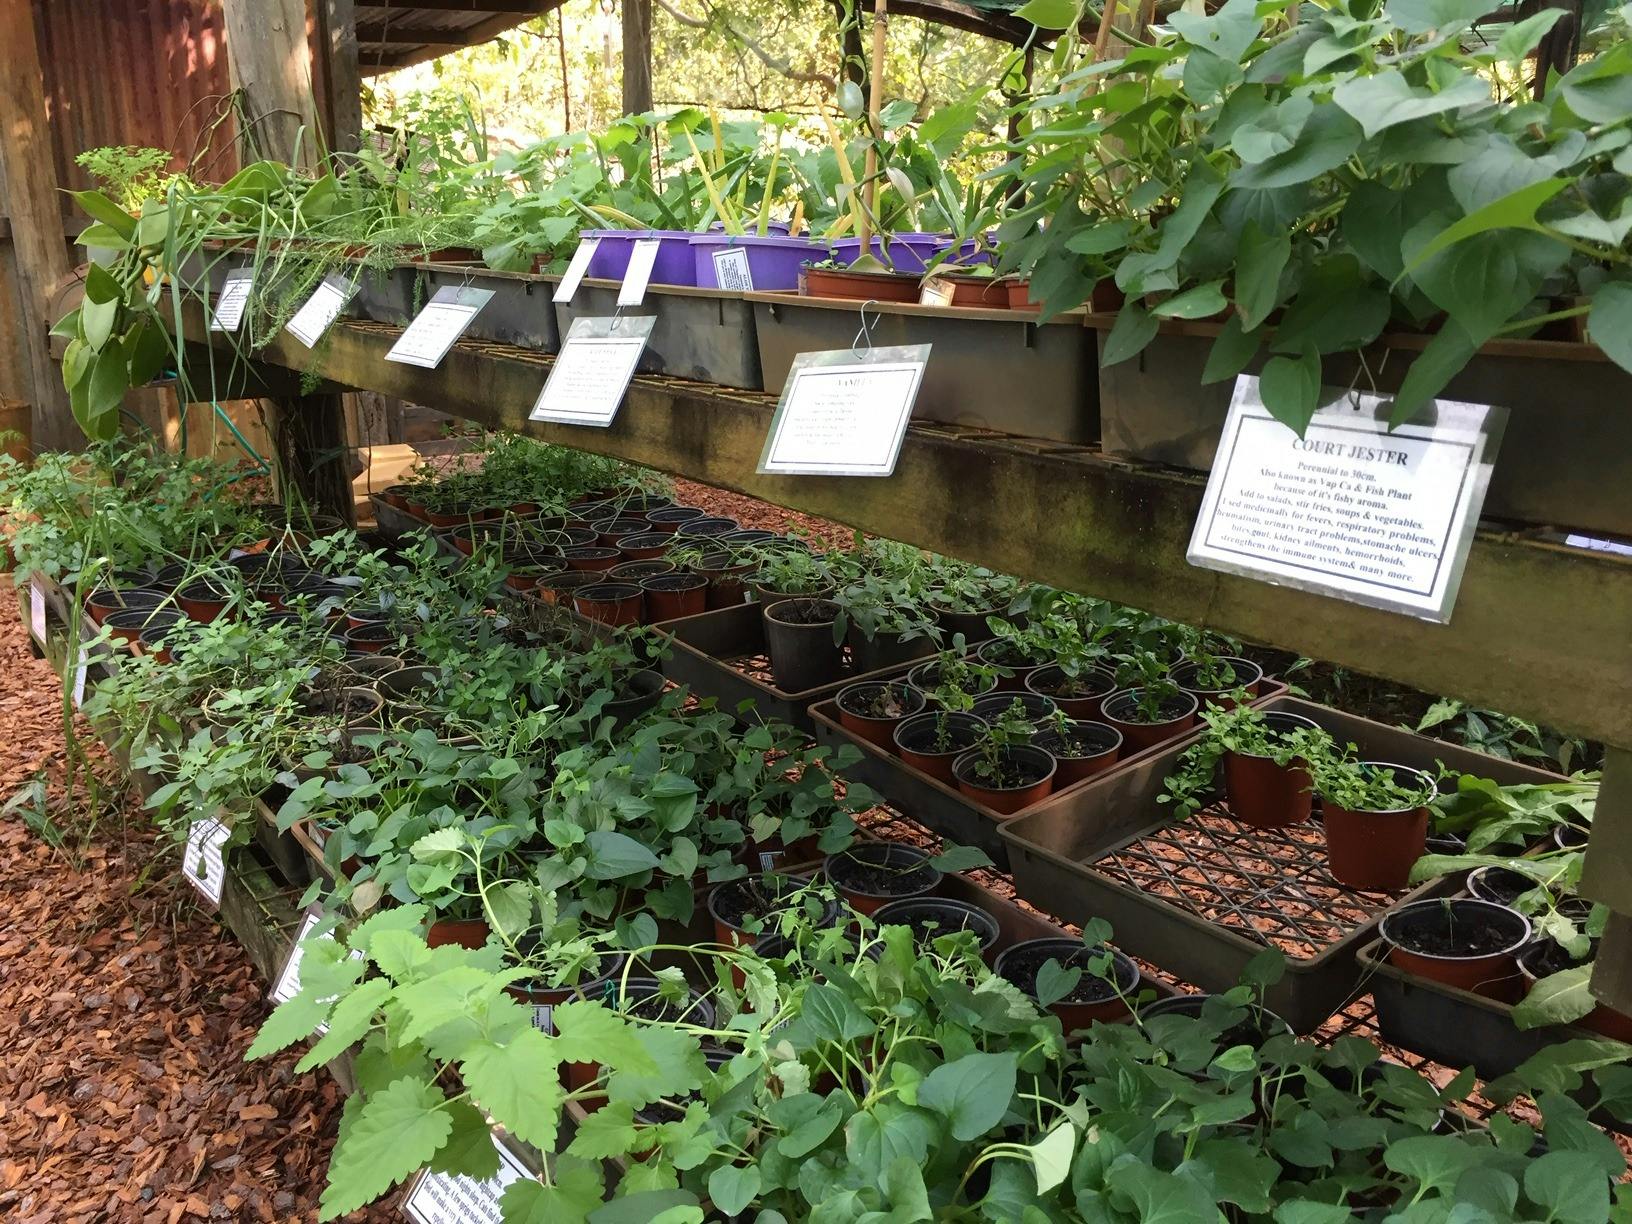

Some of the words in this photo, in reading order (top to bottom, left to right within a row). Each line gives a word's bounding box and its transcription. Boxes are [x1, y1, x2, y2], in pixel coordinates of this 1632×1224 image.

[1292, 438, 1346, 456] COURT
[1347, 445, 1409, 466] JESTER
[1261, 467, 1276, 478] Also
[1278, 471, 1306, 483] known
[1308, 477, 1317, 485] as
[1320, 477, 1337, 490] Vap
[1339, 481, 1352, 491] Ca
[1354, 483, 1363, 492] &
[1365, 485, 1385, 496] Fish
[1387, 488, 1413, 501] Plant
[1298, 461, 1338, 476] Perennial
[1340, 467, 1349, 477] to
[1351, 469, 1377, 482] 30cm.
[1240, 489, 1254, 499] Add
[1256, 492, 1265, 500] to
[1267, 494, 1293, 506] salads,
[1296, 499, 1310, 509] stir
[1312, 502, 1333, 514] fries,
[1335, 507, 1360, 519] soups
[1362, 511, 1372, 520] &
[1374, 514, 1425, 530] vegetables.
[1274, 482, 1306, 496] because
[1308, 489, 1317, 497] of
[1318, 489, 1331, 500] it's
[1333, 492, 1354, 506] fishy
[1356, 498, 1388, 510] aroma.
[1243, 502, 1288, 517] medicinally
[1291, 510, 1303, 520] for
[1306, 514, 1334, 527] fevers,
[1336, 521, 1386, 538] respiratory
[1388, 531, 1437, 547] problems,
[1264, 519, 1294, 531] urinary
[1297, 525, 1318, 536] tract
[1220, 535, 1266, 550] strengthens
[1267, 544, 1281, 553] the
[1282, 548, 1317, 561] immune
[1359, 564, 1384, 577] many
[1387, 570, 1414, 583] more.
[1274, 532, 1301, 545] kidney
[1304, 539, 1343, 555] ailments,
[1344, 547, 1406, 568] hemorrhoids,
